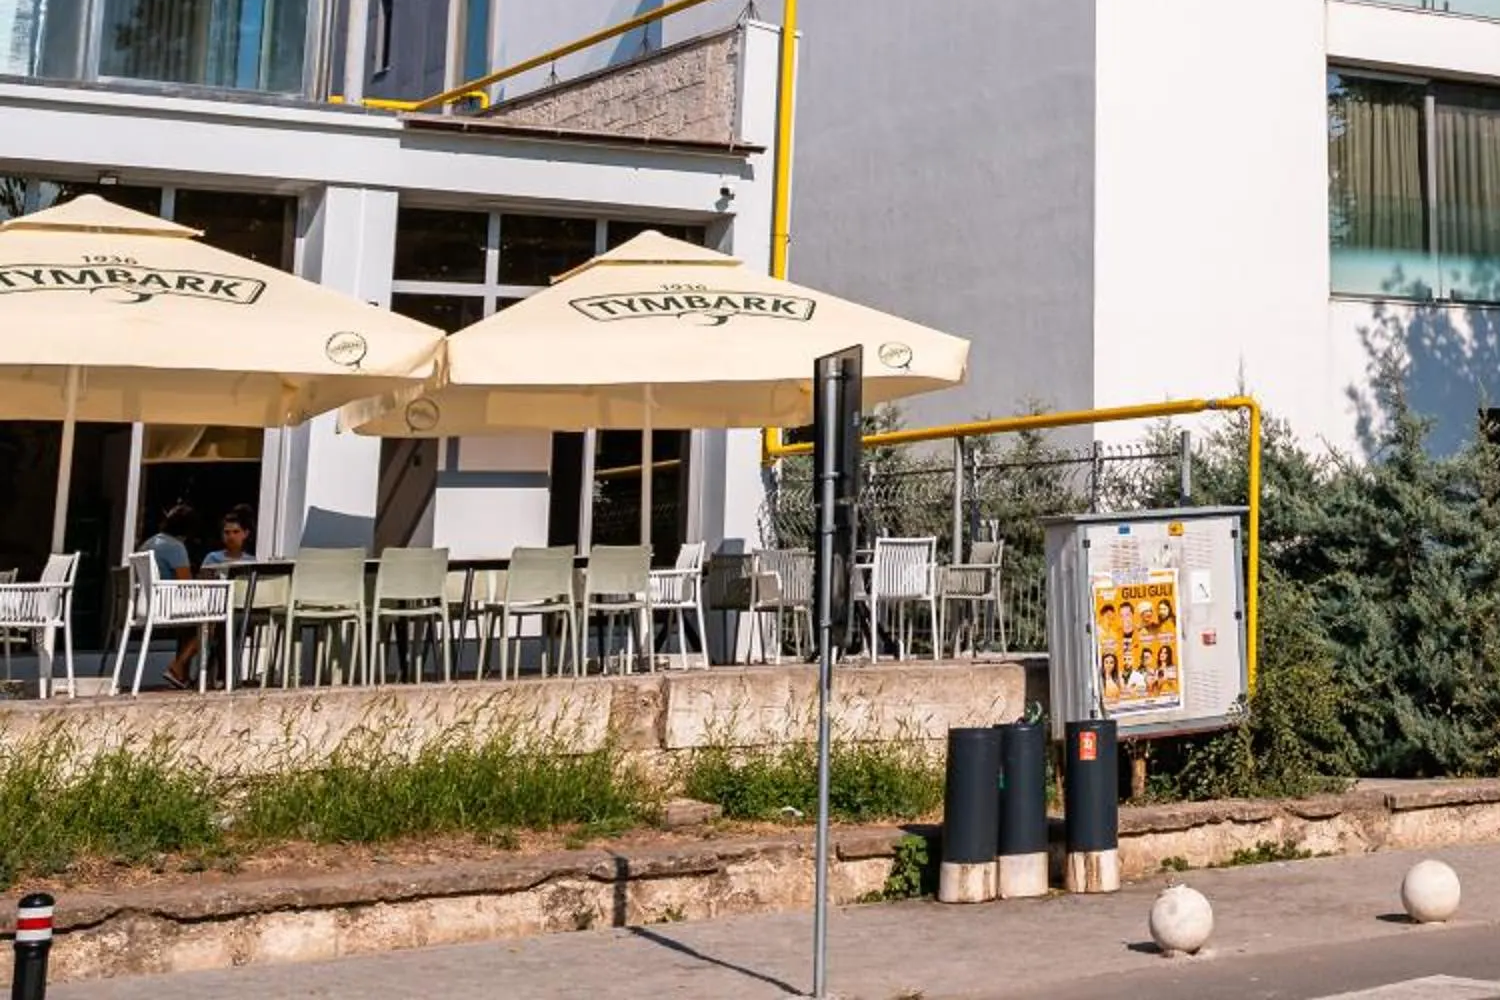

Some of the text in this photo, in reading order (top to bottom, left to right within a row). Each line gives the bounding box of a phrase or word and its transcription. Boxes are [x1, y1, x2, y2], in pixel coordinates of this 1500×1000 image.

[81, 254, 138, 265] 1936
[587, 295, 797, 315] TYMBARK
[1122, 584, 1173, 599] GULI GULI
